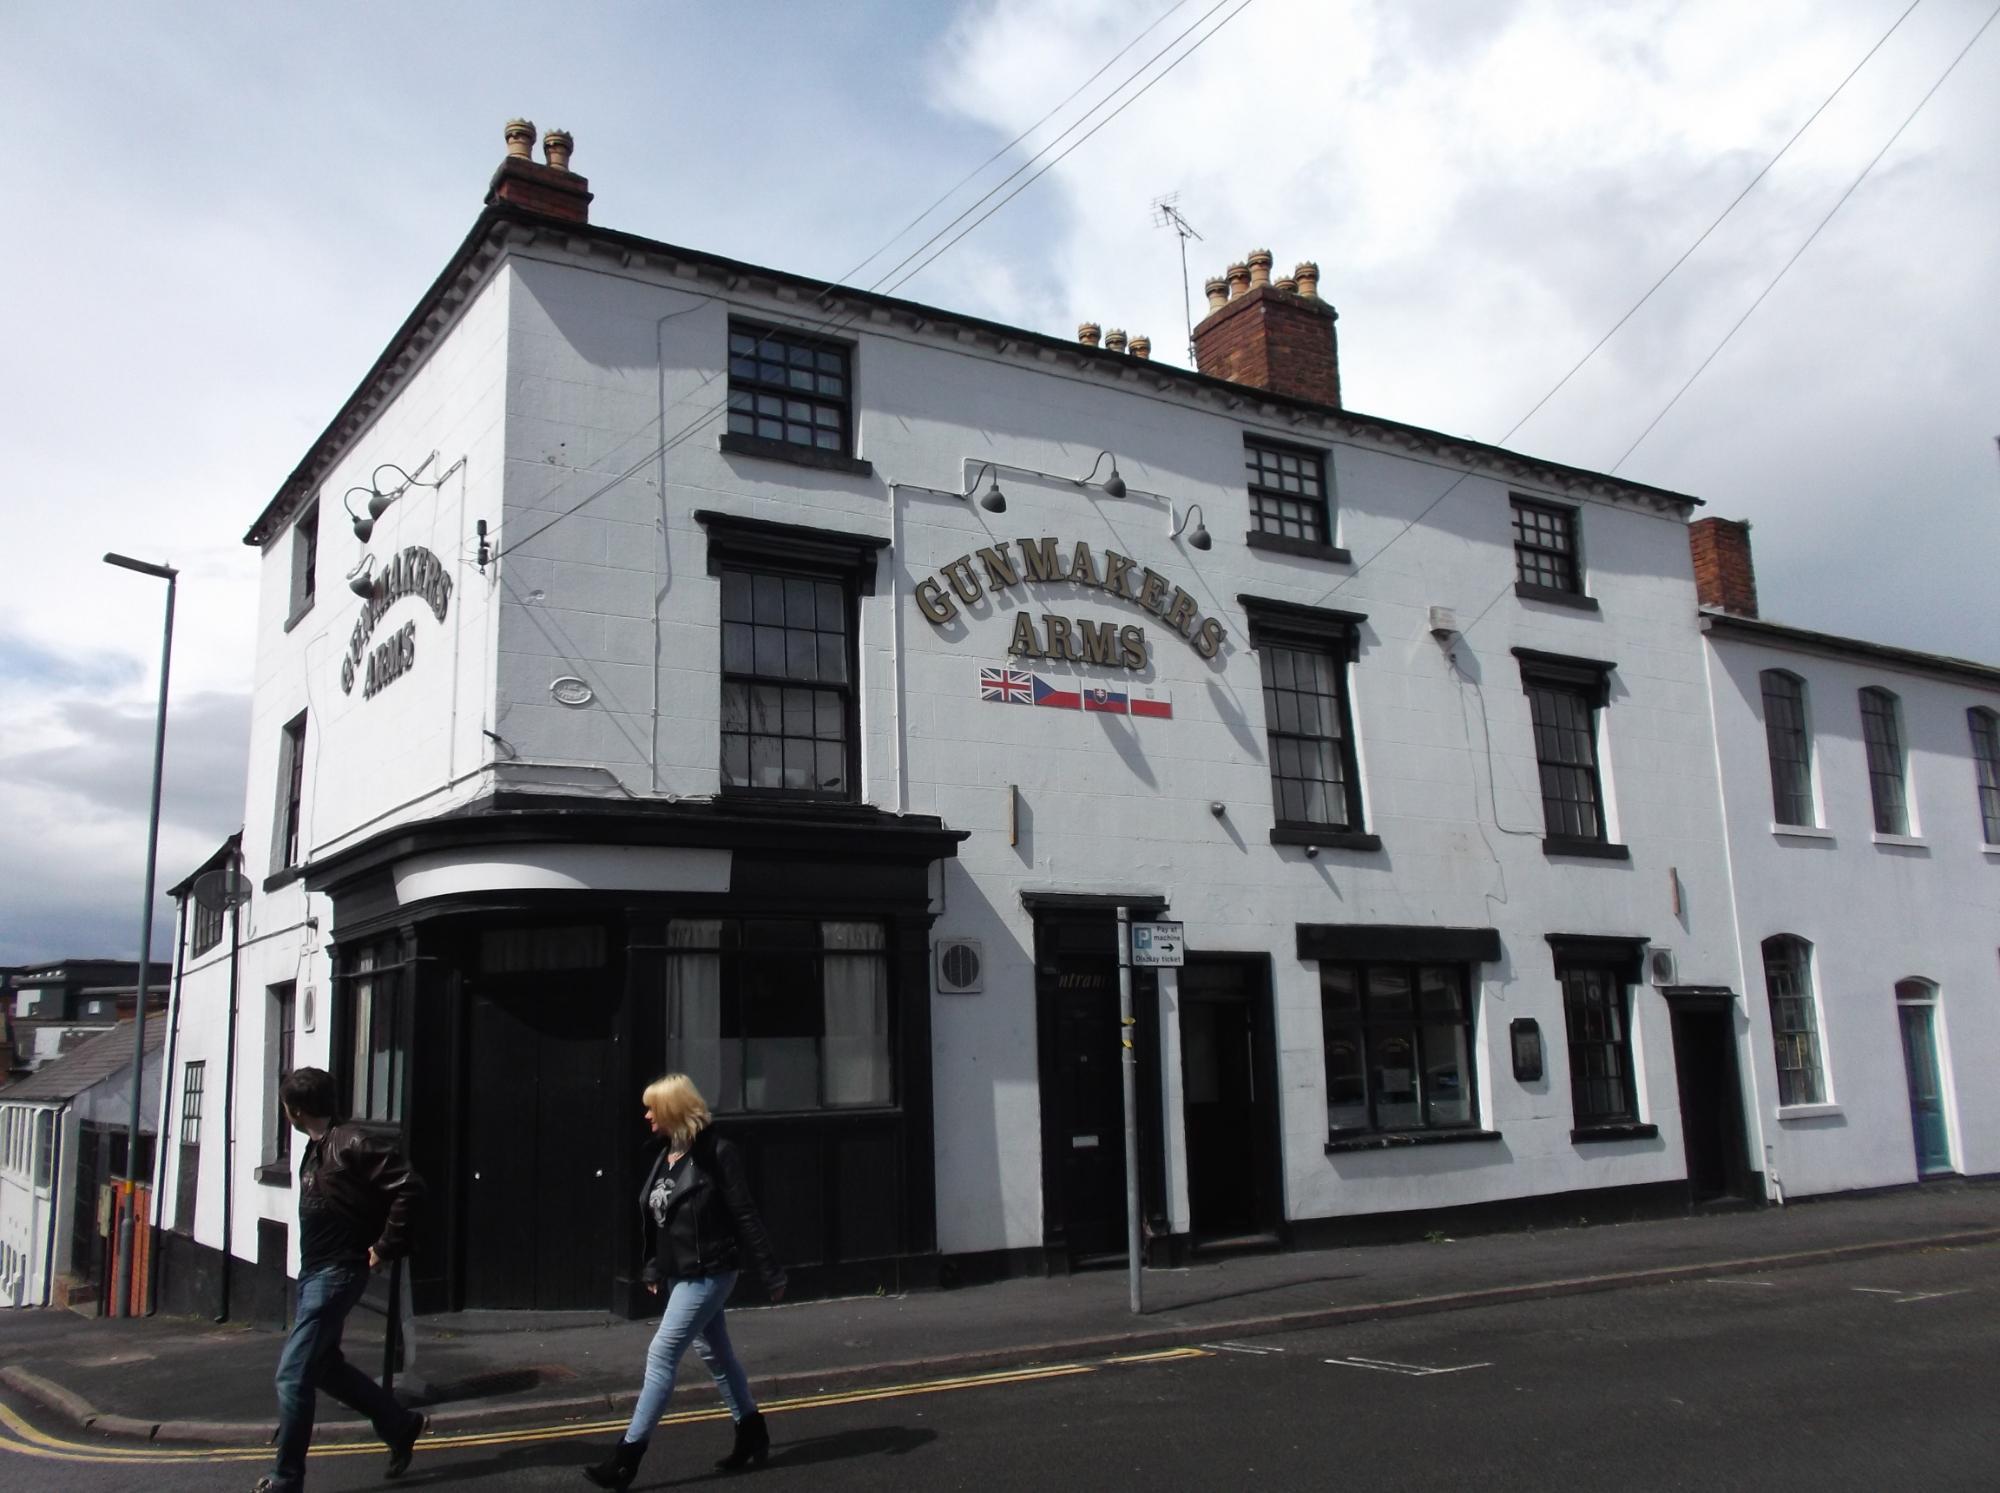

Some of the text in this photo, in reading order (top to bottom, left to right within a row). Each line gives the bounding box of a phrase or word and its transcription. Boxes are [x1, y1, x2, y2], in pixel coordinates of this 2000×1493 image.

[914, 537, 1228, 660] GUNMAKERS
[362, 619, 416, 701] ARMS
[1007, 611, 1148, 671] ARMS
[1135, 954, 1160, 963] Display
[1156, 925, 1169, 934] Pay
